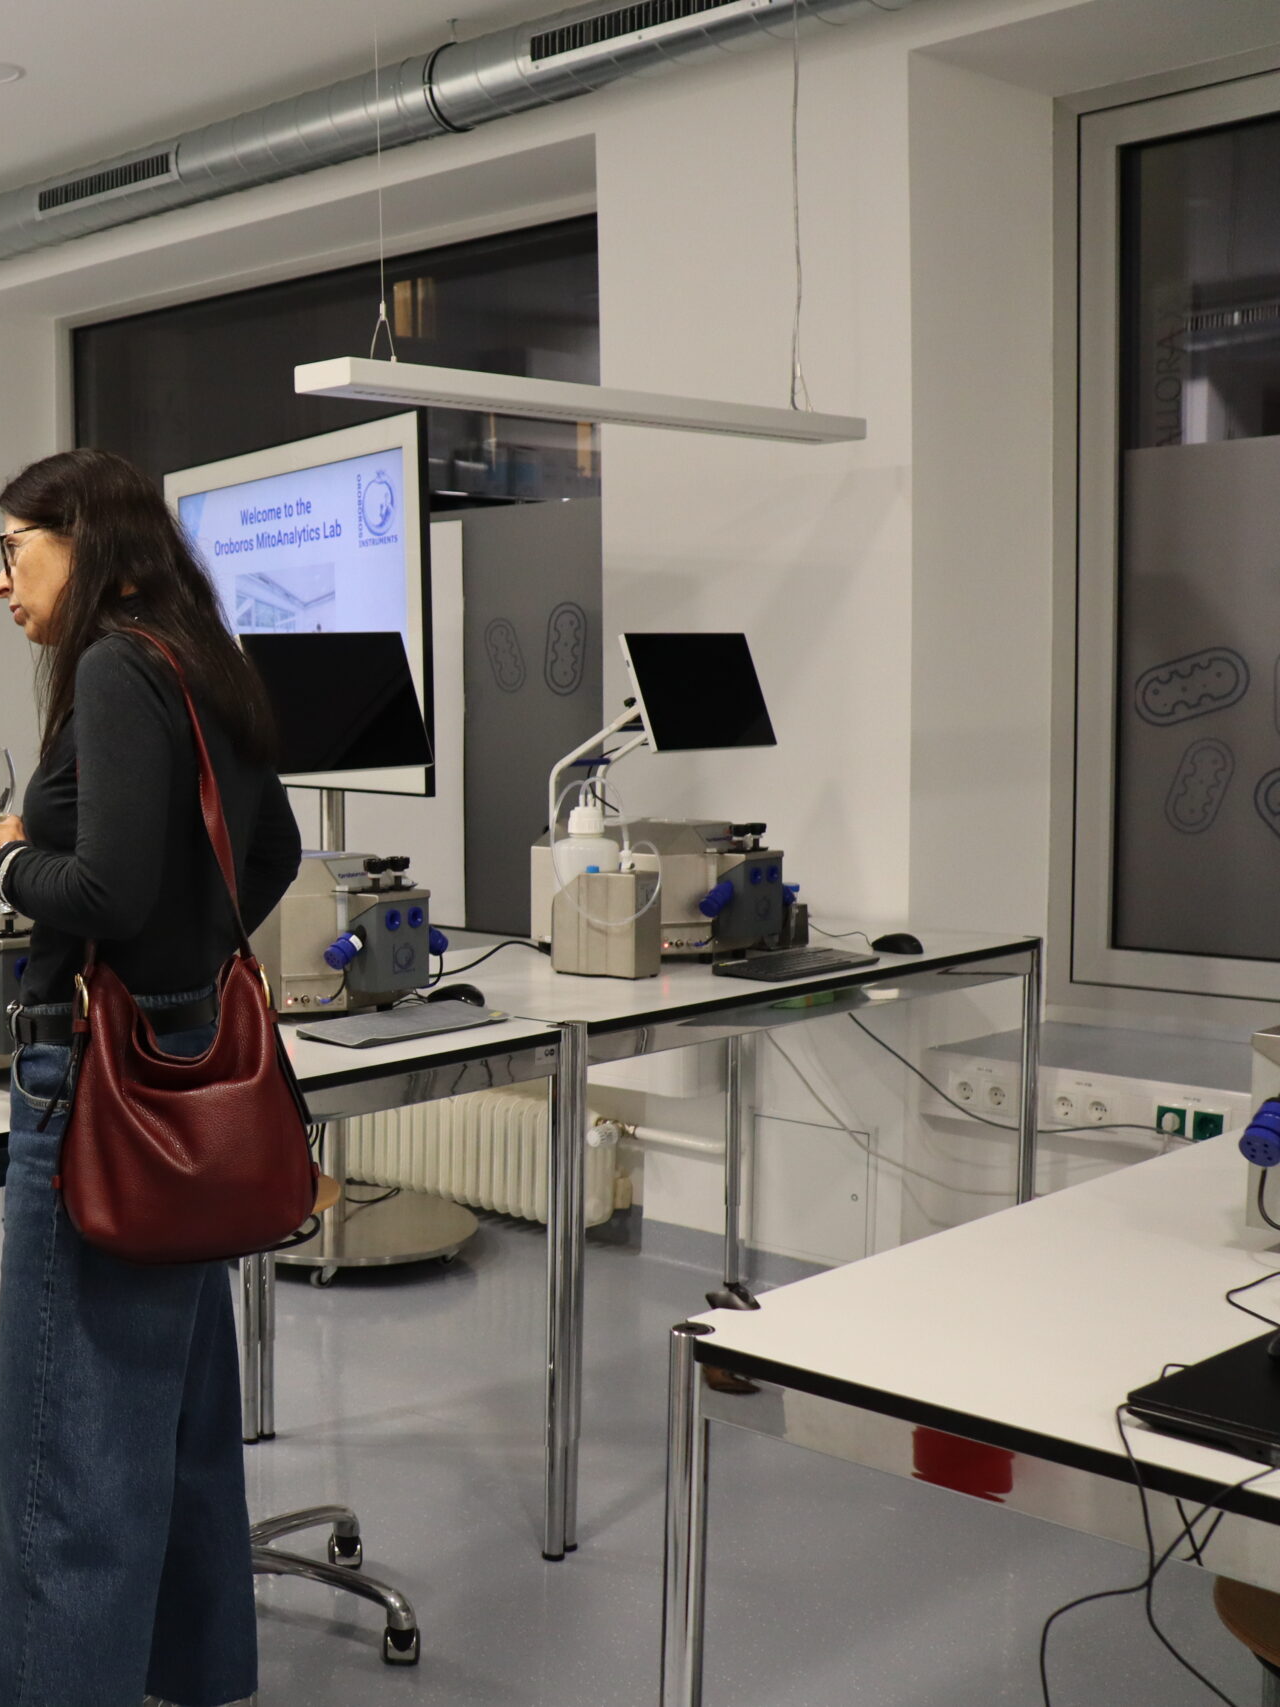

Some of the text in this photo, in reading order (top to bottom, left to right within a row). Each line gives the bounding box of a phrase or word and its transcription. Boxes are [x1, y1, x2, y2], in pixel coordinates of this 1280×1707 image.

[240, 498, 312, 526] Welcome to the
[214, 519, 341, 556] Oroboros MitoAnalytics Lab
[358, 534, 398, 549] INSTRUMENTS
